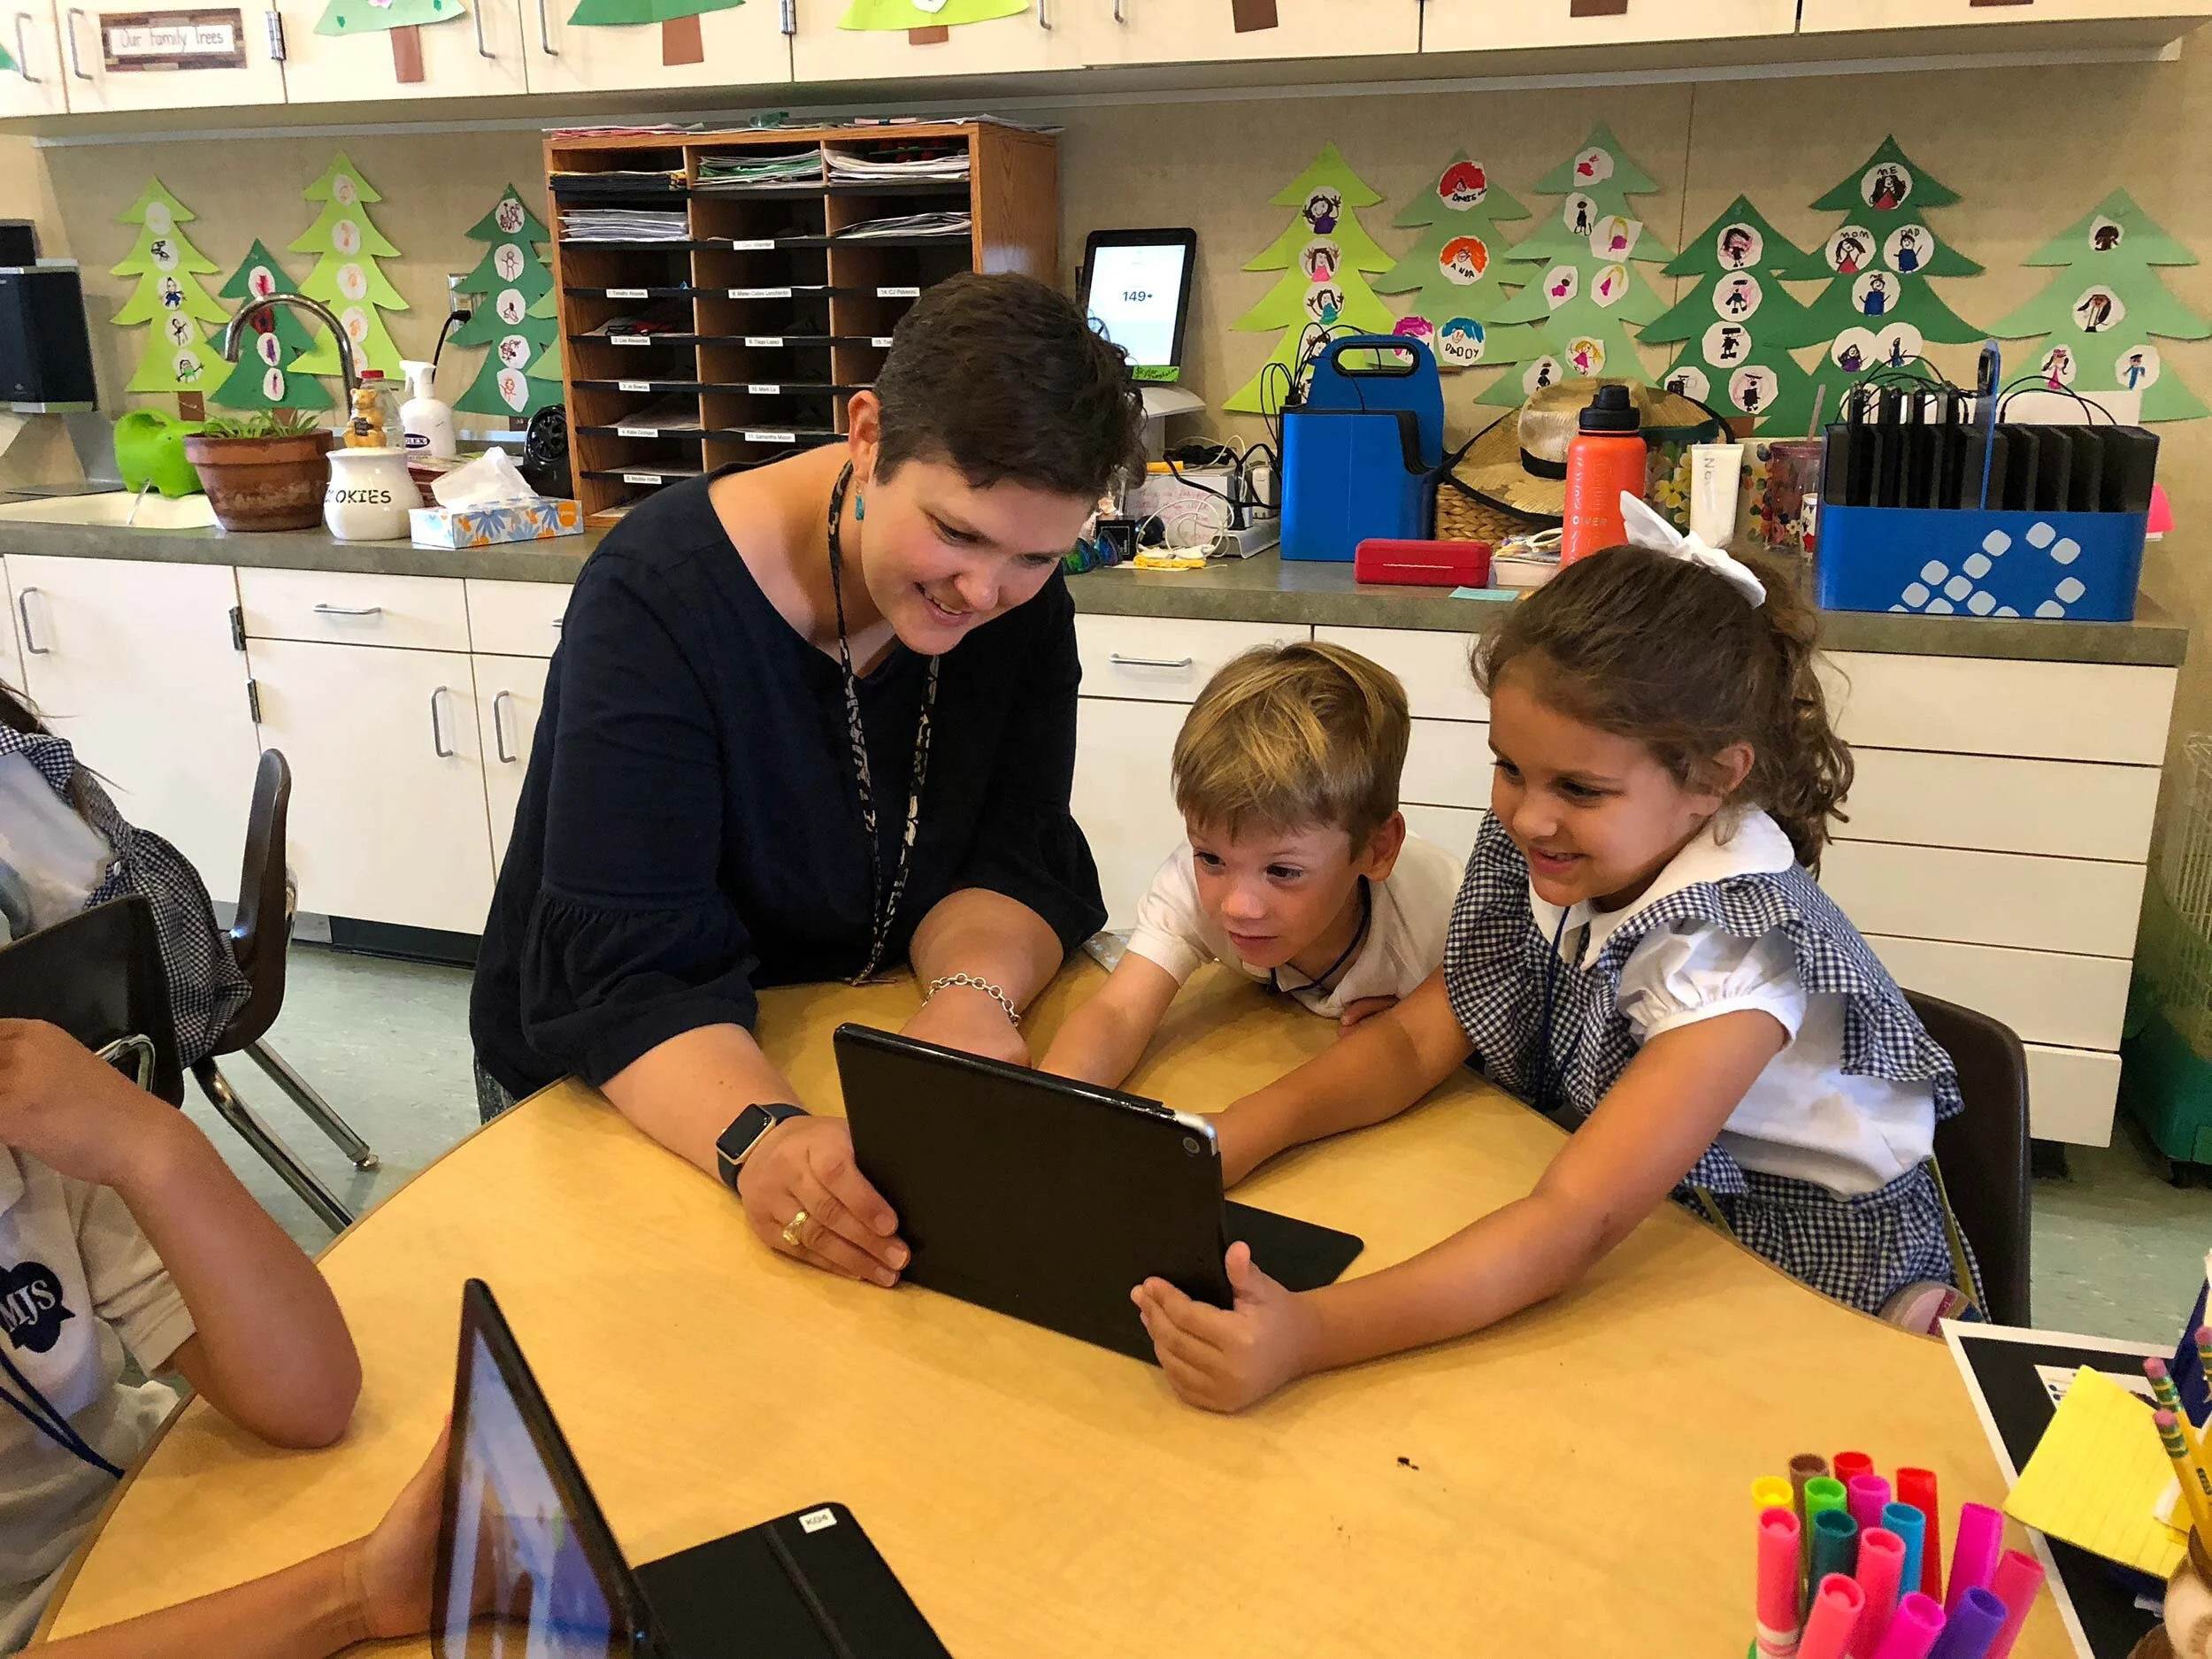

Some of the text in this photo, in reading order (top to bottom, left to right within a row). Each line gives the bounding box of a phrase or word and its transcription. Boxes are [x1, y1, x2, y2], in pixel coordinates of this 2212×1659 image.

[120, 25, 224, 52] Our Family Trees
[1877, 165, 1898, 175] ME
[1840, 230, 1870, 239] MOM
[1901, 227, 1920, 237] DAD
[1445, 342, 1479, 359] DADDY
[0, 1279, 56, 1333] MJS
